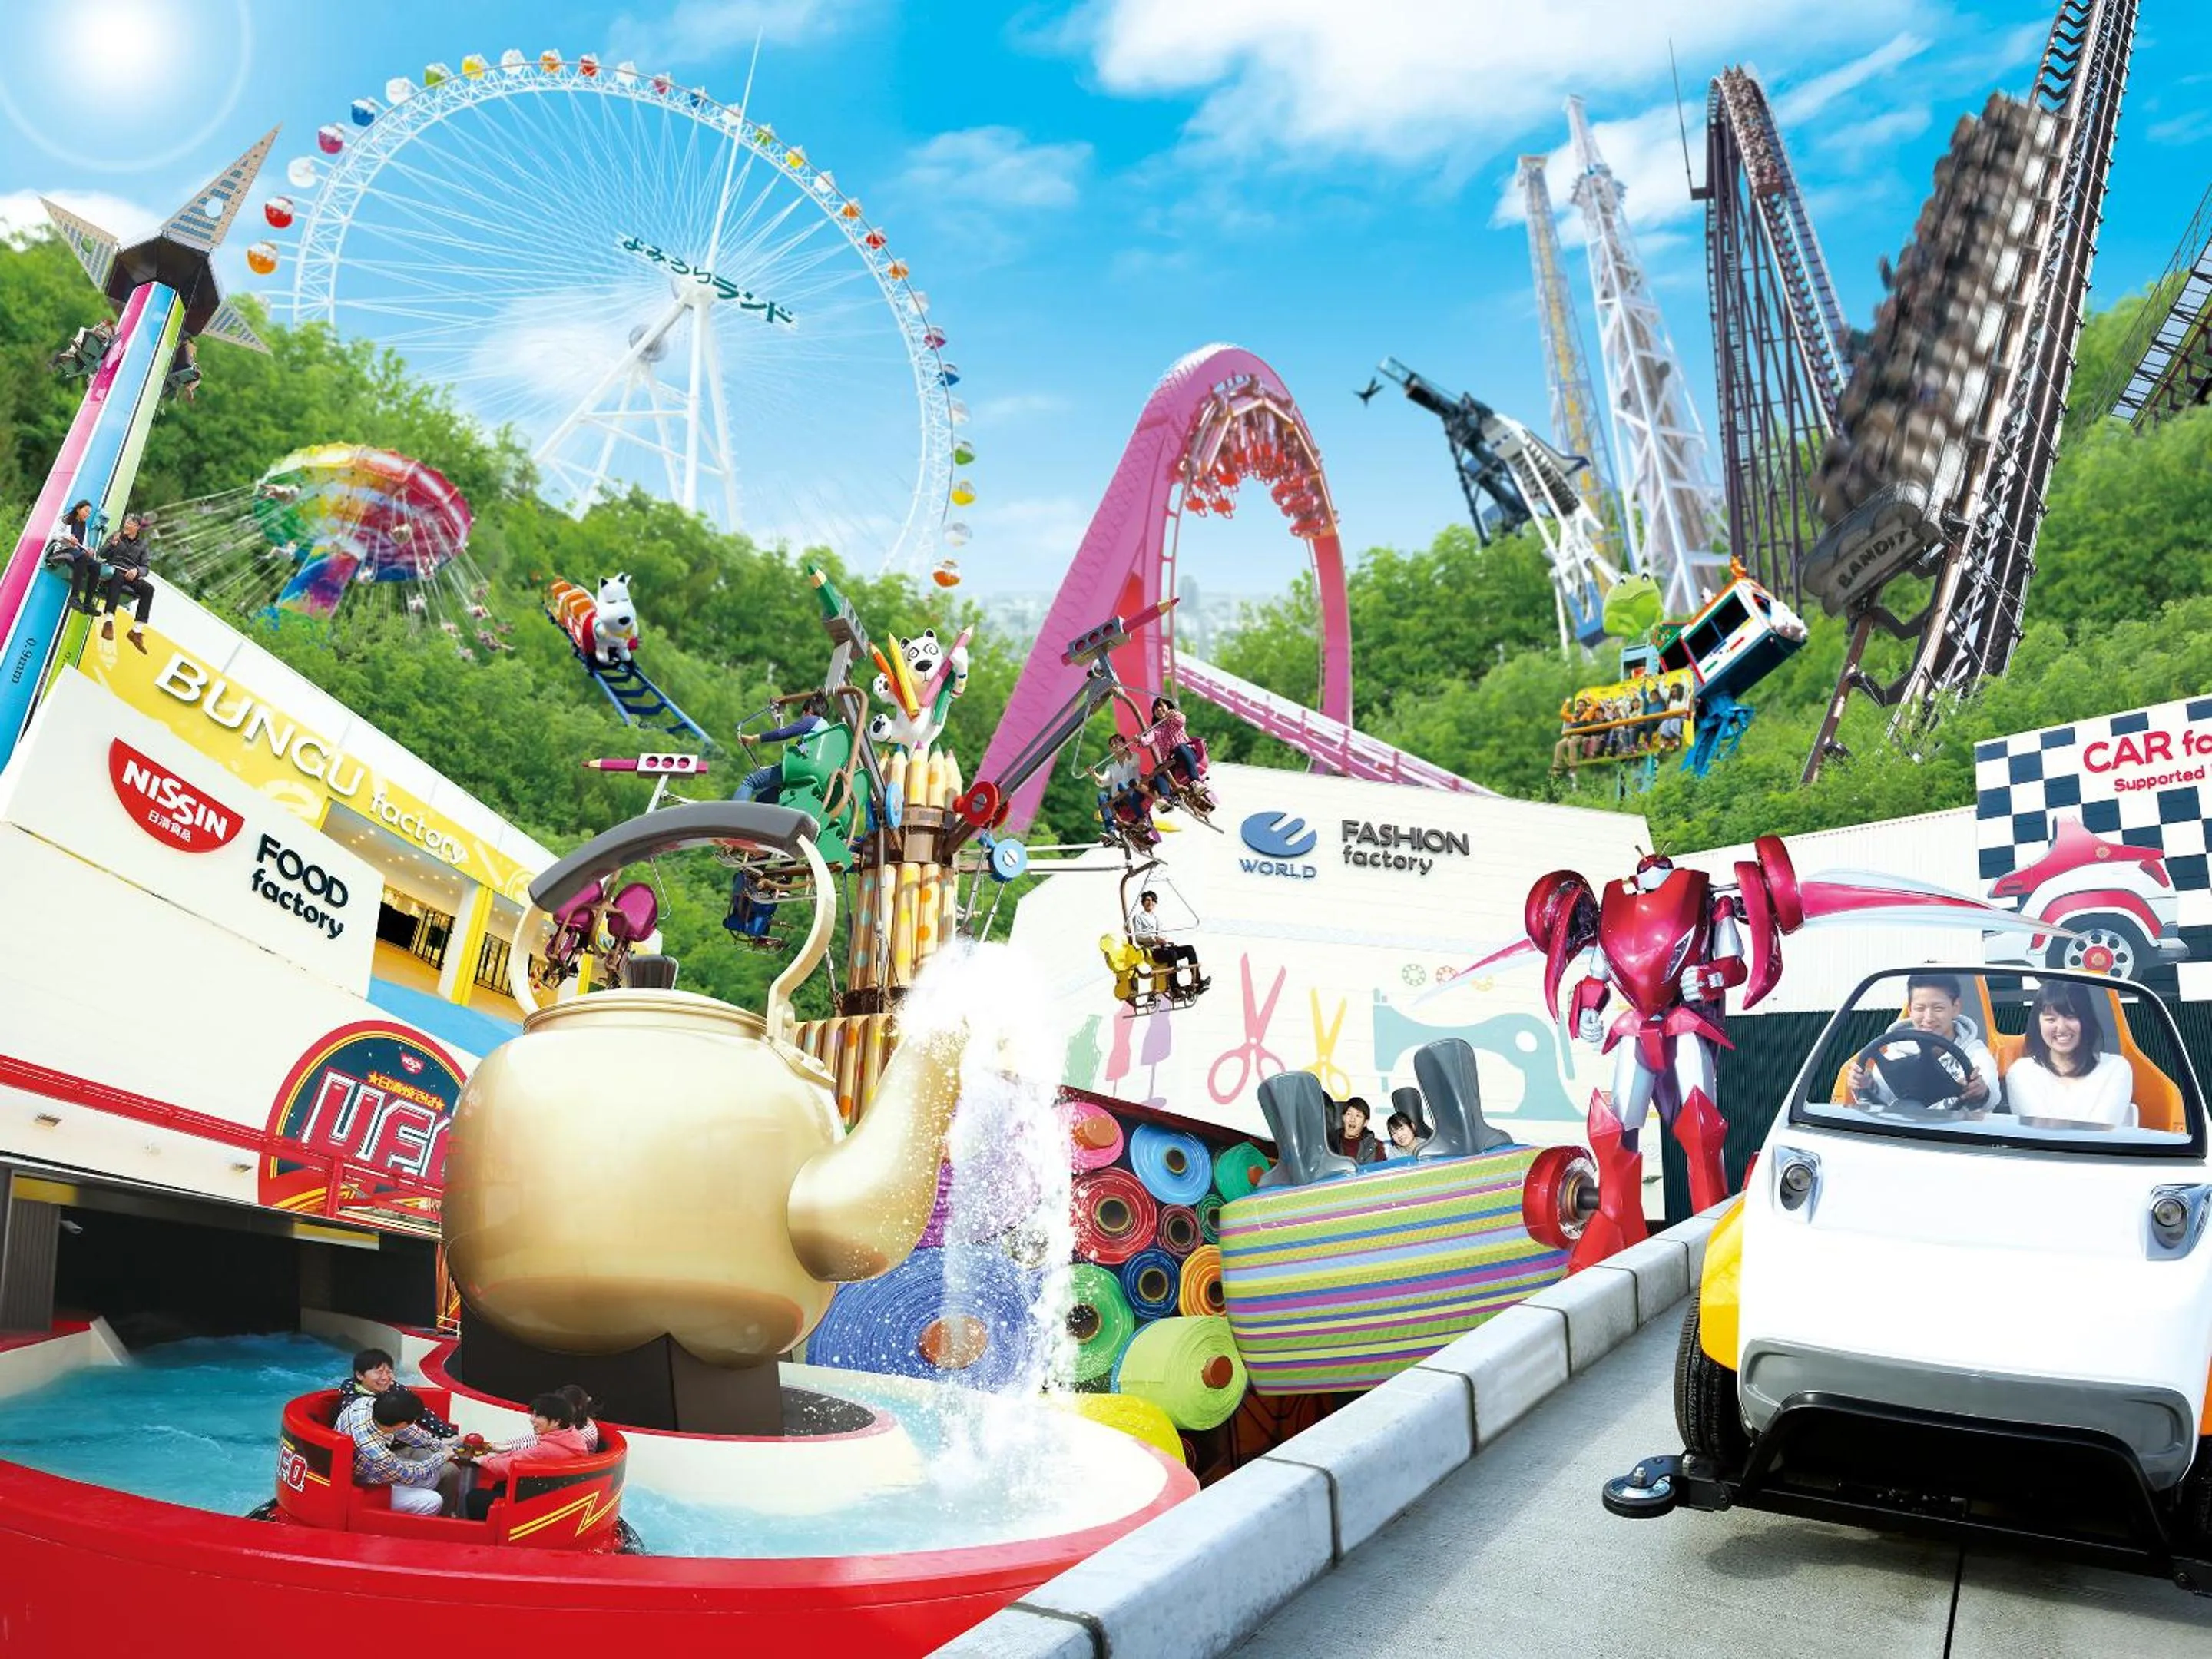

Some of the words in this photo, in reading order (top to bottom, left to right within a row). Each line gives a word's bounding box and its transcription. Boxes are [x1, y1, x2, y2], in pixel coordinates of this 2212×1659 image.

[623, 237, 793, 324] よみうりランド
[1837, 529, 1909, 589] BANDIT
[154, 653, 366, 797] BUNGU
[369, 791, 469, 865] factory
[2083, 730, 2174, 773] CAR
[2114, 765, 2205, 792] Supported
[122, 759, 228, 840] NISSIN
[1341, 820, 1470, 856] FASHION
[1343, 845, 1433, 875] factory
[256, 833, 349, 909] FOOD
[1239, 859, 1317, 879] WORLD
[251, 868, 344, 939] factory
